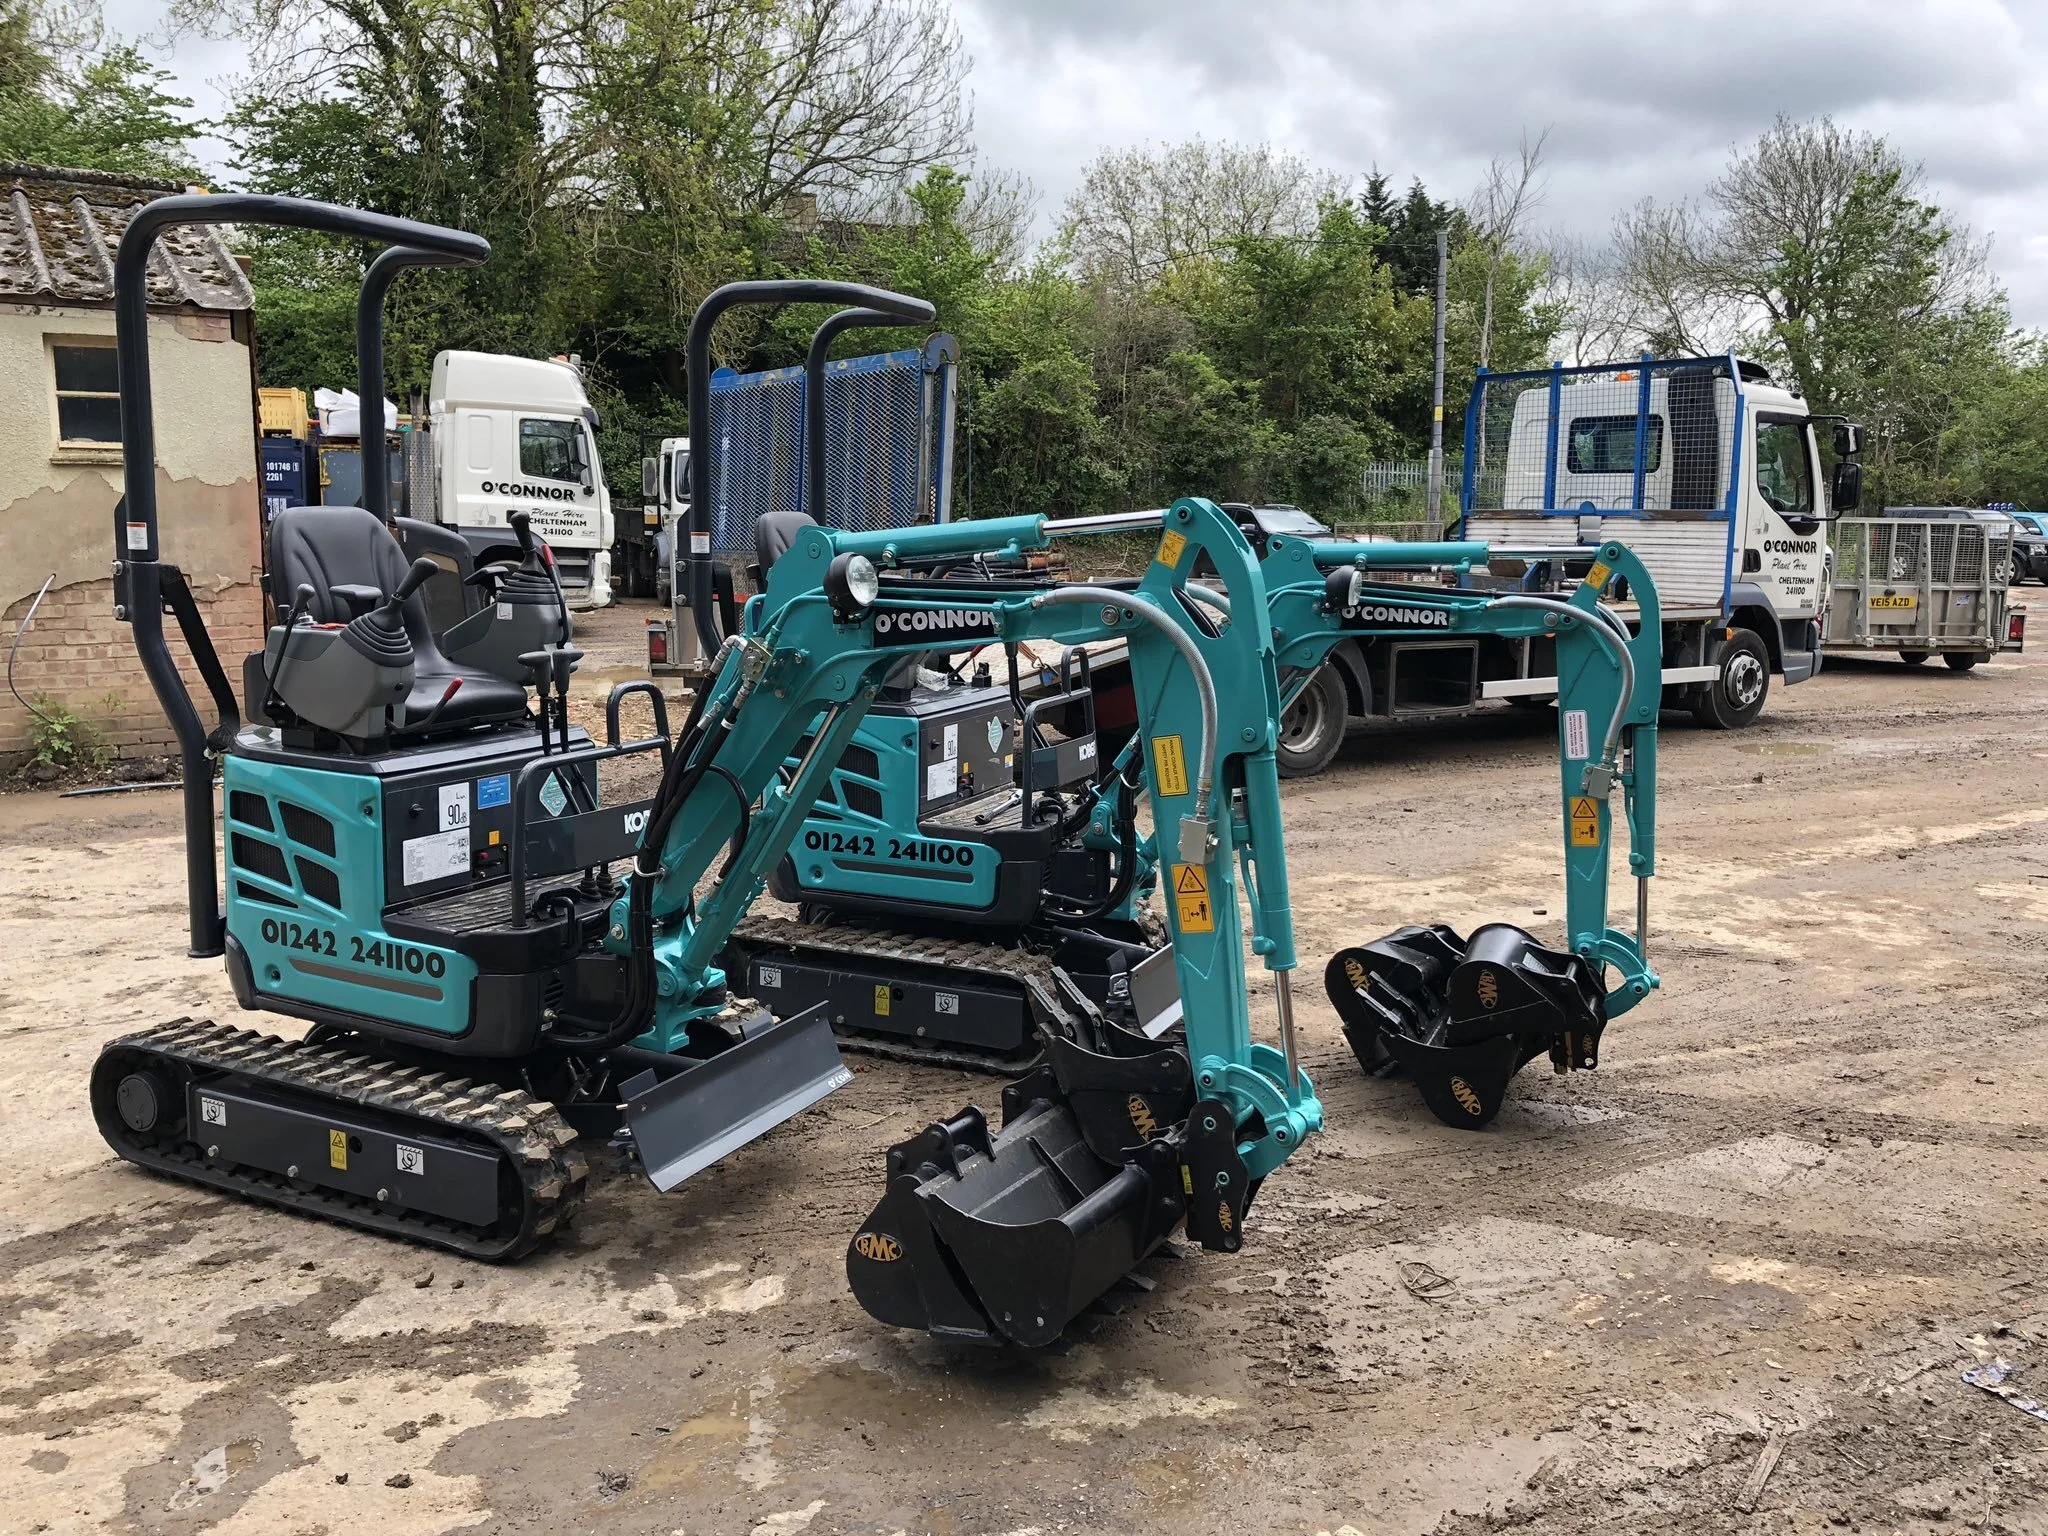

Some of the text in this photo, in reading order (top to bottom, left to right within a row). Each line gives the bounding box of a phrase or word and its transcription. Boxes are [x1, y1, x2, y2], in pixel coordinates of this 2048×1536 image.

[266, 462, 291, 471] 101746
[481, 481, 575, 501] O'CONNOR
[528, 518, 587, 527] CHELTENHAM
[531, 507, 585, 518] Plant Hire
[542, 528, 573, 536] 241100
[1763, 539, 1817, 554] O'CONNOR
[1771, 557, 1808, 571] Plant Hire
[1778, 576, 1815, 585] CHELTENHAM
[1785, 587, 1806, 595] 241100
[1870, 597, 1910, 607] VE15 AZD
[875, 609, 996, 633] O'CONNOR
[1341, 605, 1448, 626] O'CONNOR
[804, 830, 974, 867] 01242 241100
[261, 918, 446, 979] 01242 241100
[1479, 973, 1497, 1008] BMC
[1452, 1080, 1481, 1115] BMC
[1129, 1098, 1156, 1141] BM
[1219, 1202, 1232, 1232] BMC
[858, 1233, 901, 1261] BMC
